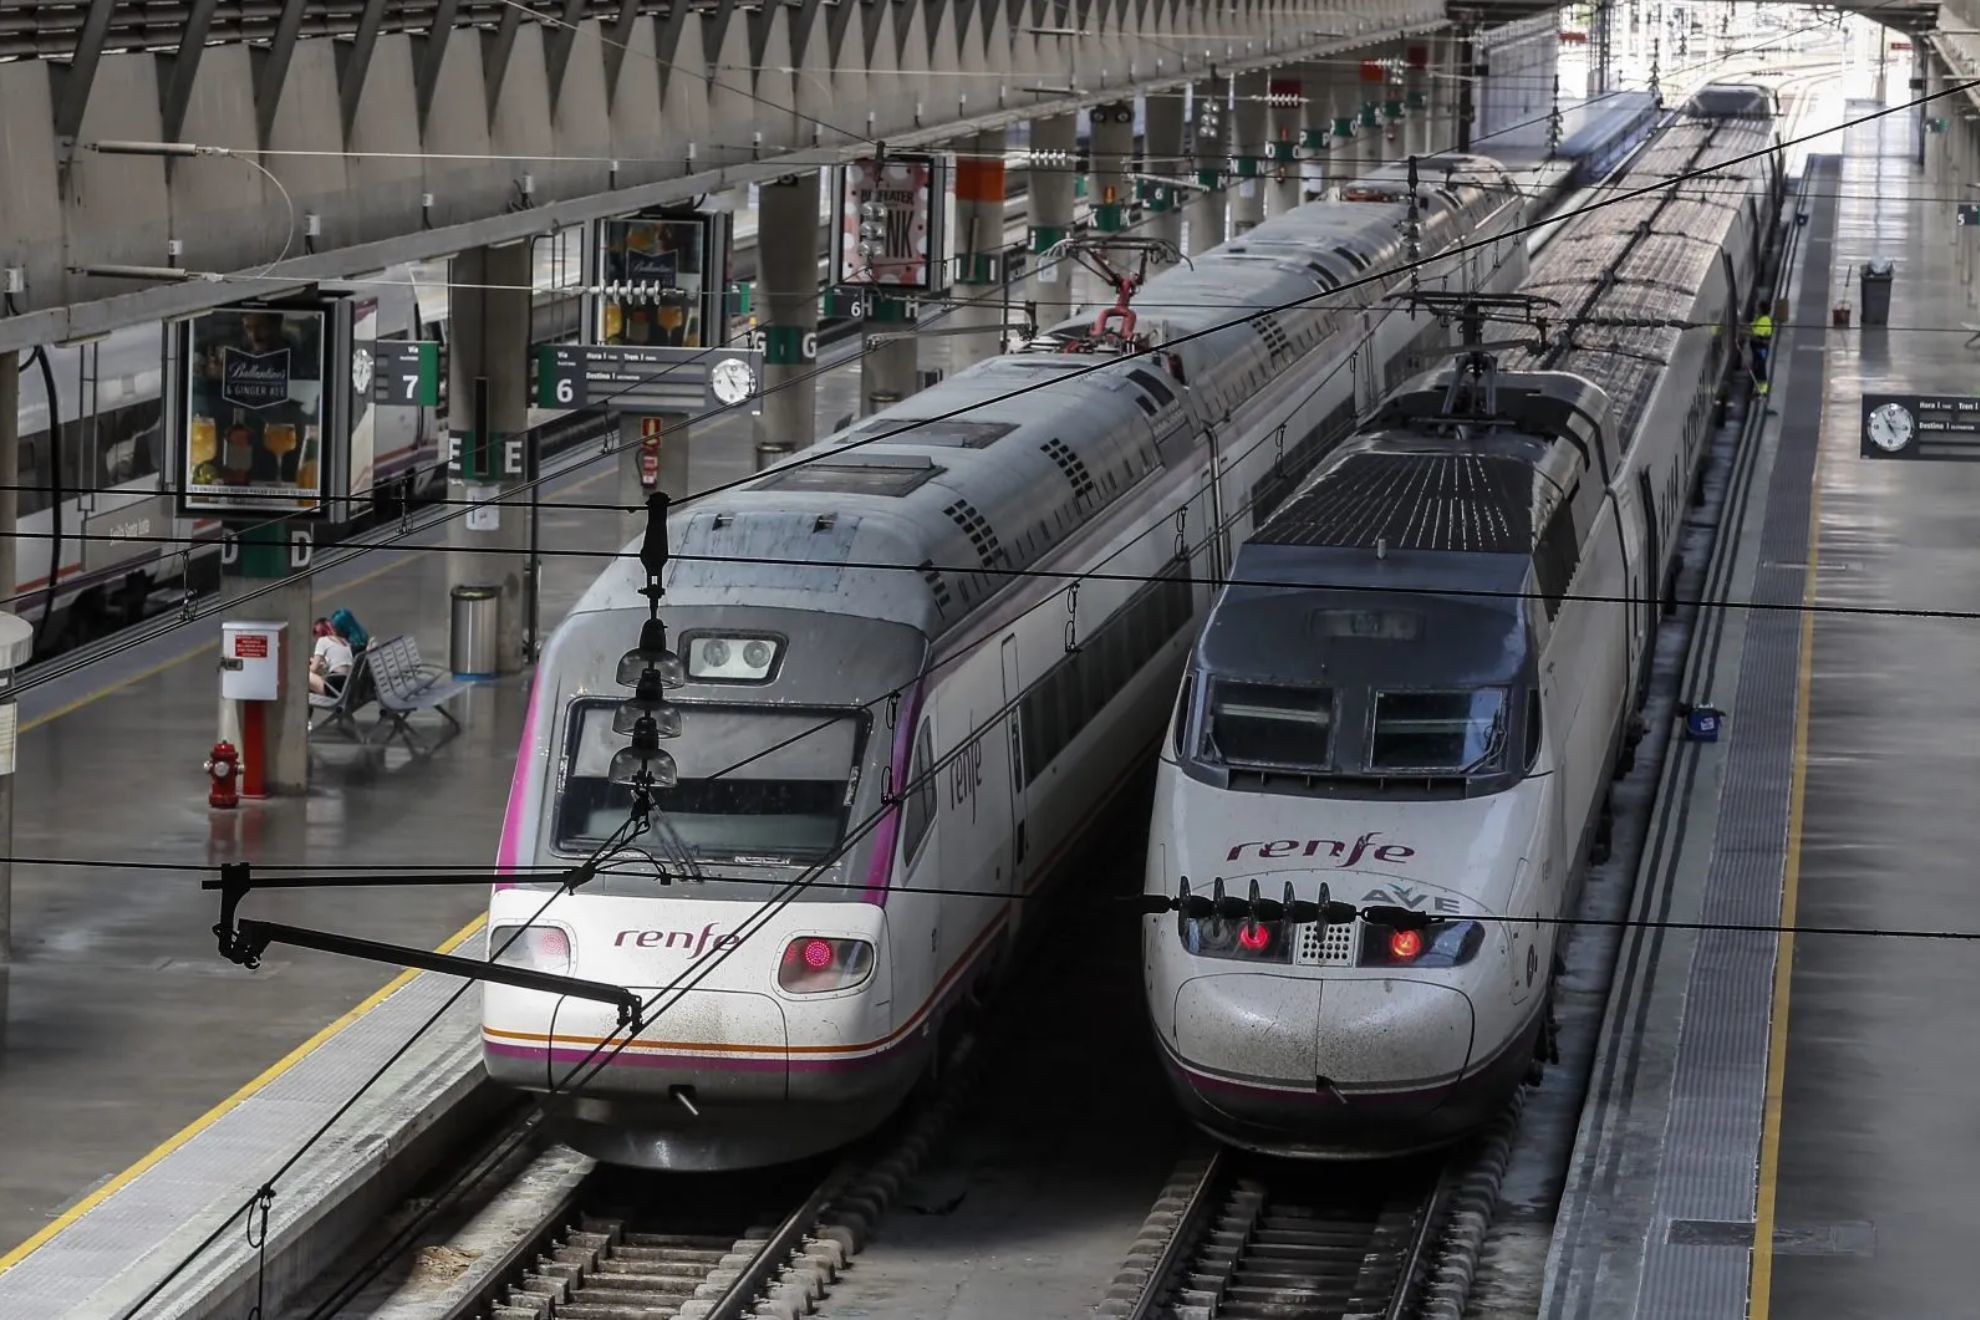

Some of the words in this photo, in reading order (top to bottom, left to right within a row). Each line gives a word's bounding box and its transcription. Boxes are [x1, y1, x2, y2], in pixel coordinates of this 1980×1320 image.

[850, 301, 861, 317] 6
[802, 332, 817, 358] G
[234, 385, 266, 396] GINGER
[403, 375, 419, 399] 7
[556, 378, 574, 402] 6
[1919, 421, 1945, 429] Destino
[448, 438, 462, 470] E
[505, 441, 522, 473] E
[291, 530, 312, 567] D
[950, 709, 982, 824] renfe
[1227, 832, 1415, 868] renfe
[1361, 887, 1461, 914] AVE
[614, 922, 740, 960] renfe
